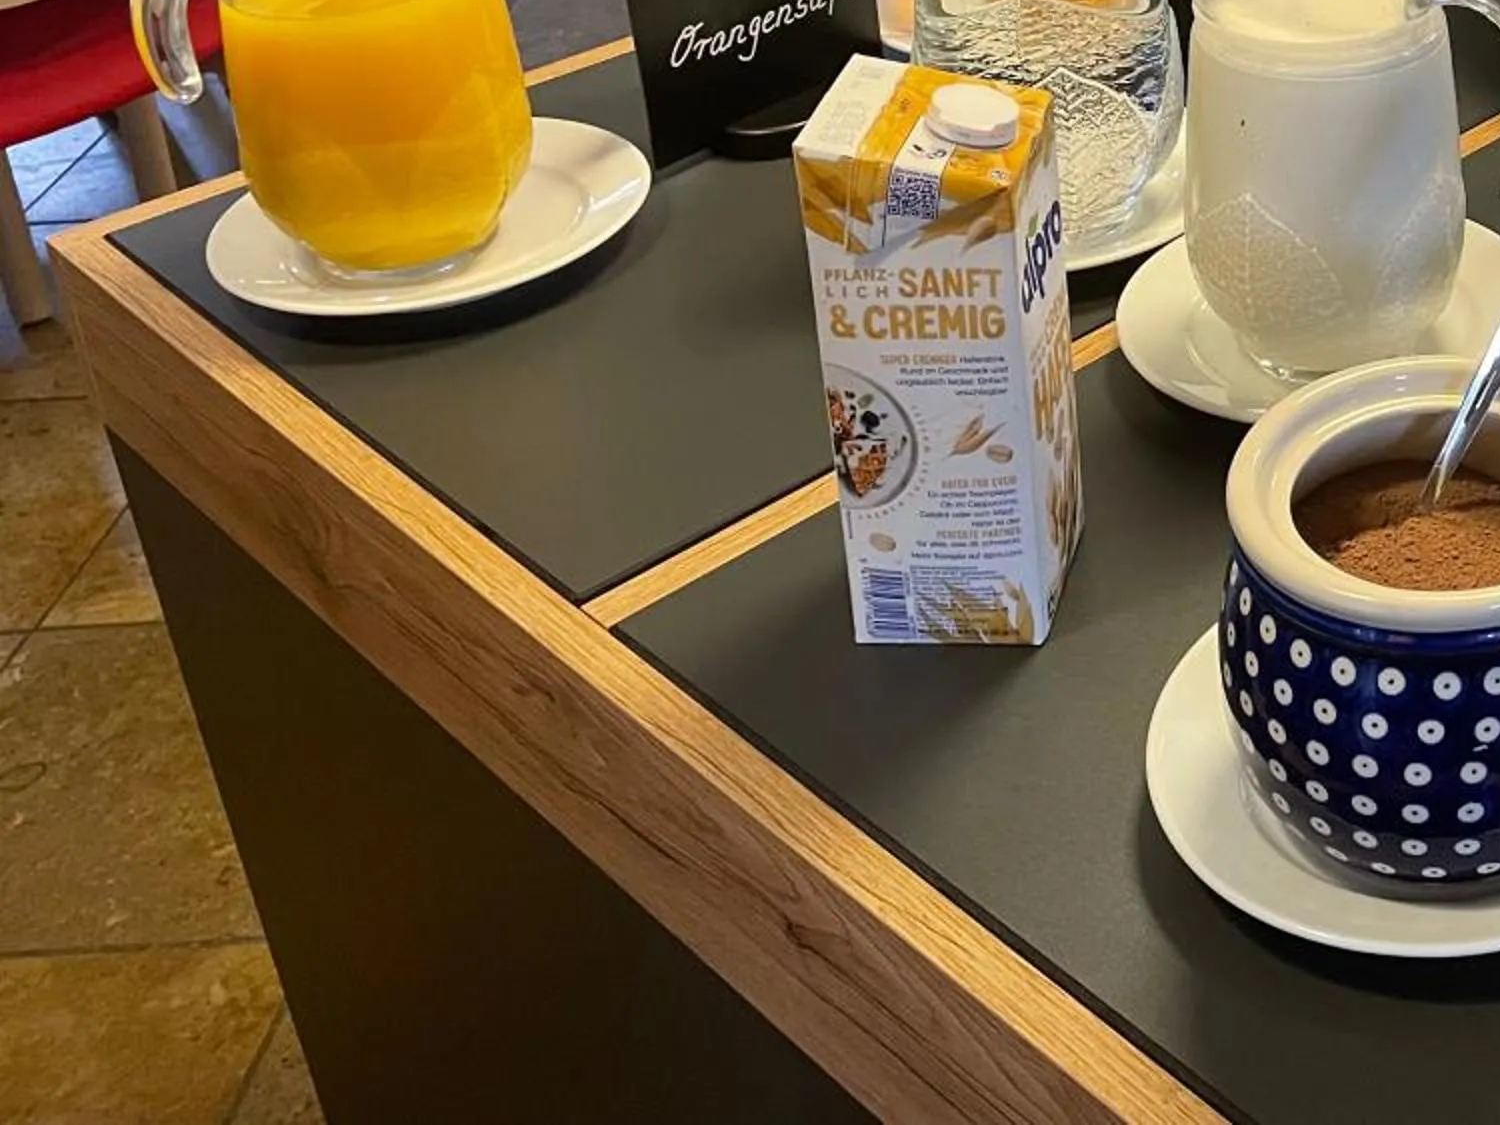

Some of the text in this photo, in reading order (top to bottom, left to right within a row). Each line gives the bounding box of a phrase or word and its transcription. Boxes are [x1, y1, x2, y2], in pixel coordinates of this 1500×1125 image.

[1021, 200, 1061, 314] alpro
[826, 285, 889, 299] LICH
[899, 266, 1003, 298] SANFT
[830, 304, 1006, 340] & CREMIG
